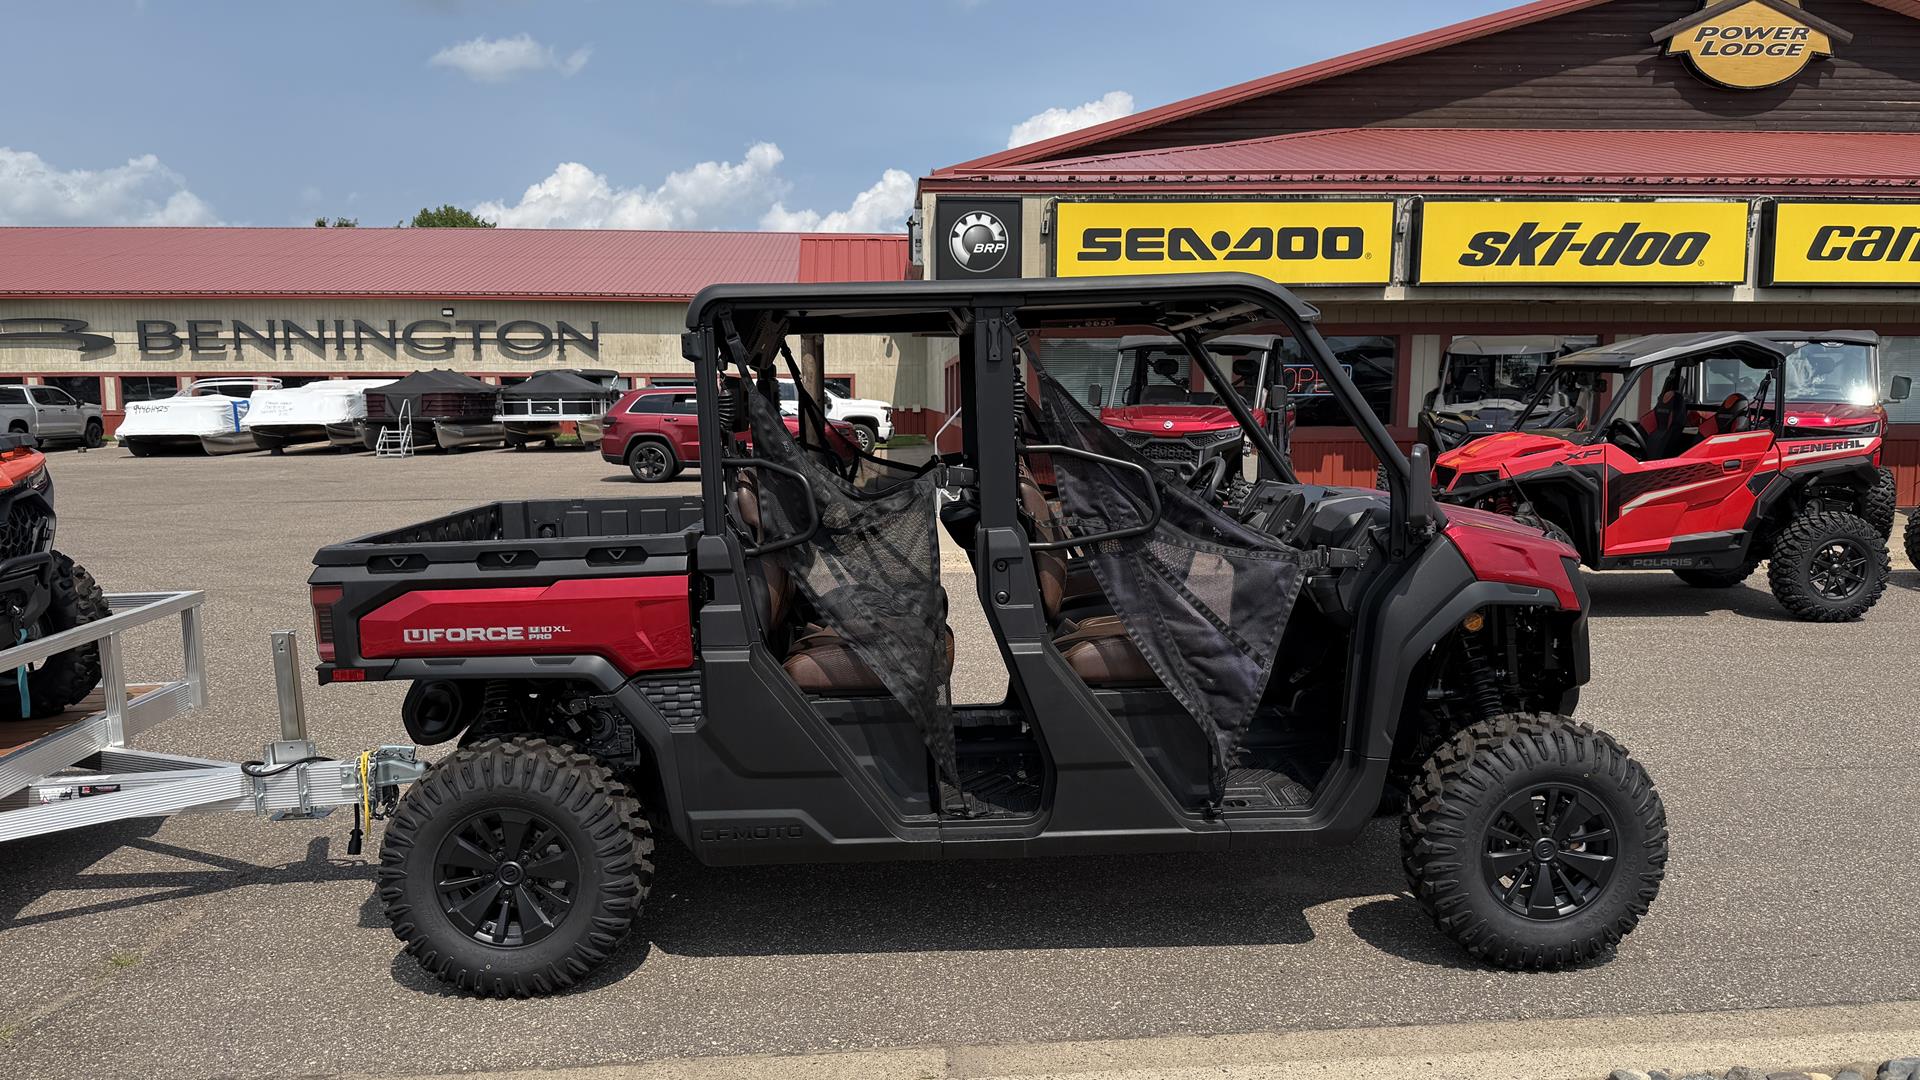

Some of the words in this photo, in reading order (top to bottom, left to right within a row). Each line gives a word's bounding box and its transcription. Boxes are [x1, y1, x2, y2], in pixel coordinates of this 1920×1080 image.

[1694, 26, 1810, 42] POWER
[1700, 40, 1805, 56] LODGE
[973, 243, 1005, 253] BRP
[1458, 222, 1711, 266] ski-doo
[136, 319, 599, 354] BENNINGTON
[1283, 367, 1350, 393] OPE
[1788, 439, 1865, 454] GENERAL
[1562, 449, 1603, 461] XP
[1633, 558, 1693, 566] POLARIS
